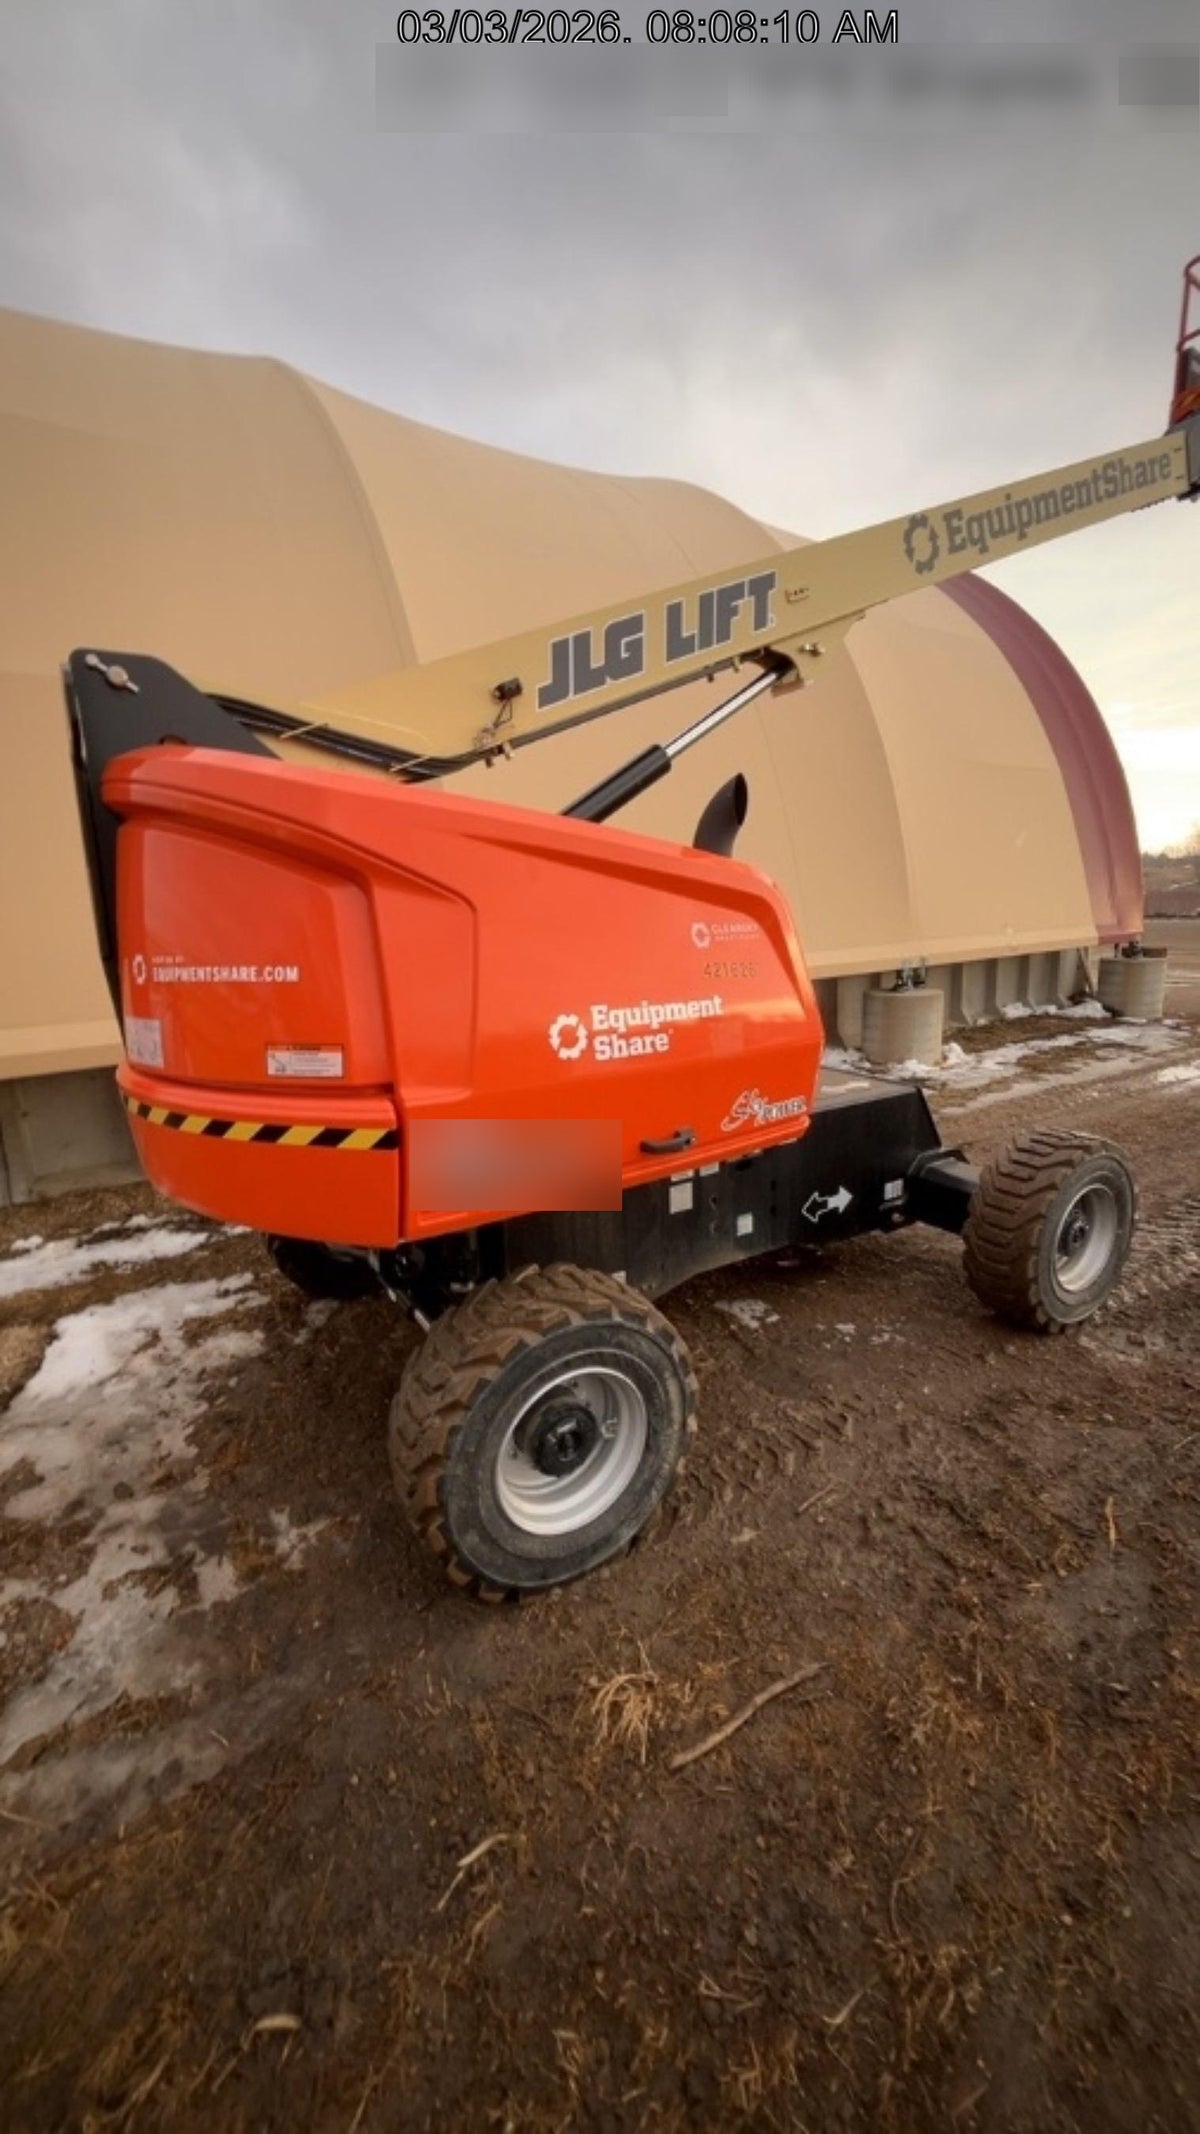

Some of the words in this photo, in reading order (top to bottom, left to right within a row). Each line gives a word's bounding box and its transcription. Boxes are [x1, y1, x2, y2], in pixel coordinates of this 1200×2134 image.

[944, 451, 1171, 554] EquipmentShare
[537, 609, 646, 711] JLG
[664, 570, 777, 662] LIFT
[591, 995, 723, 1033] Equipment
[594, 1032, 670, 1060] Share
